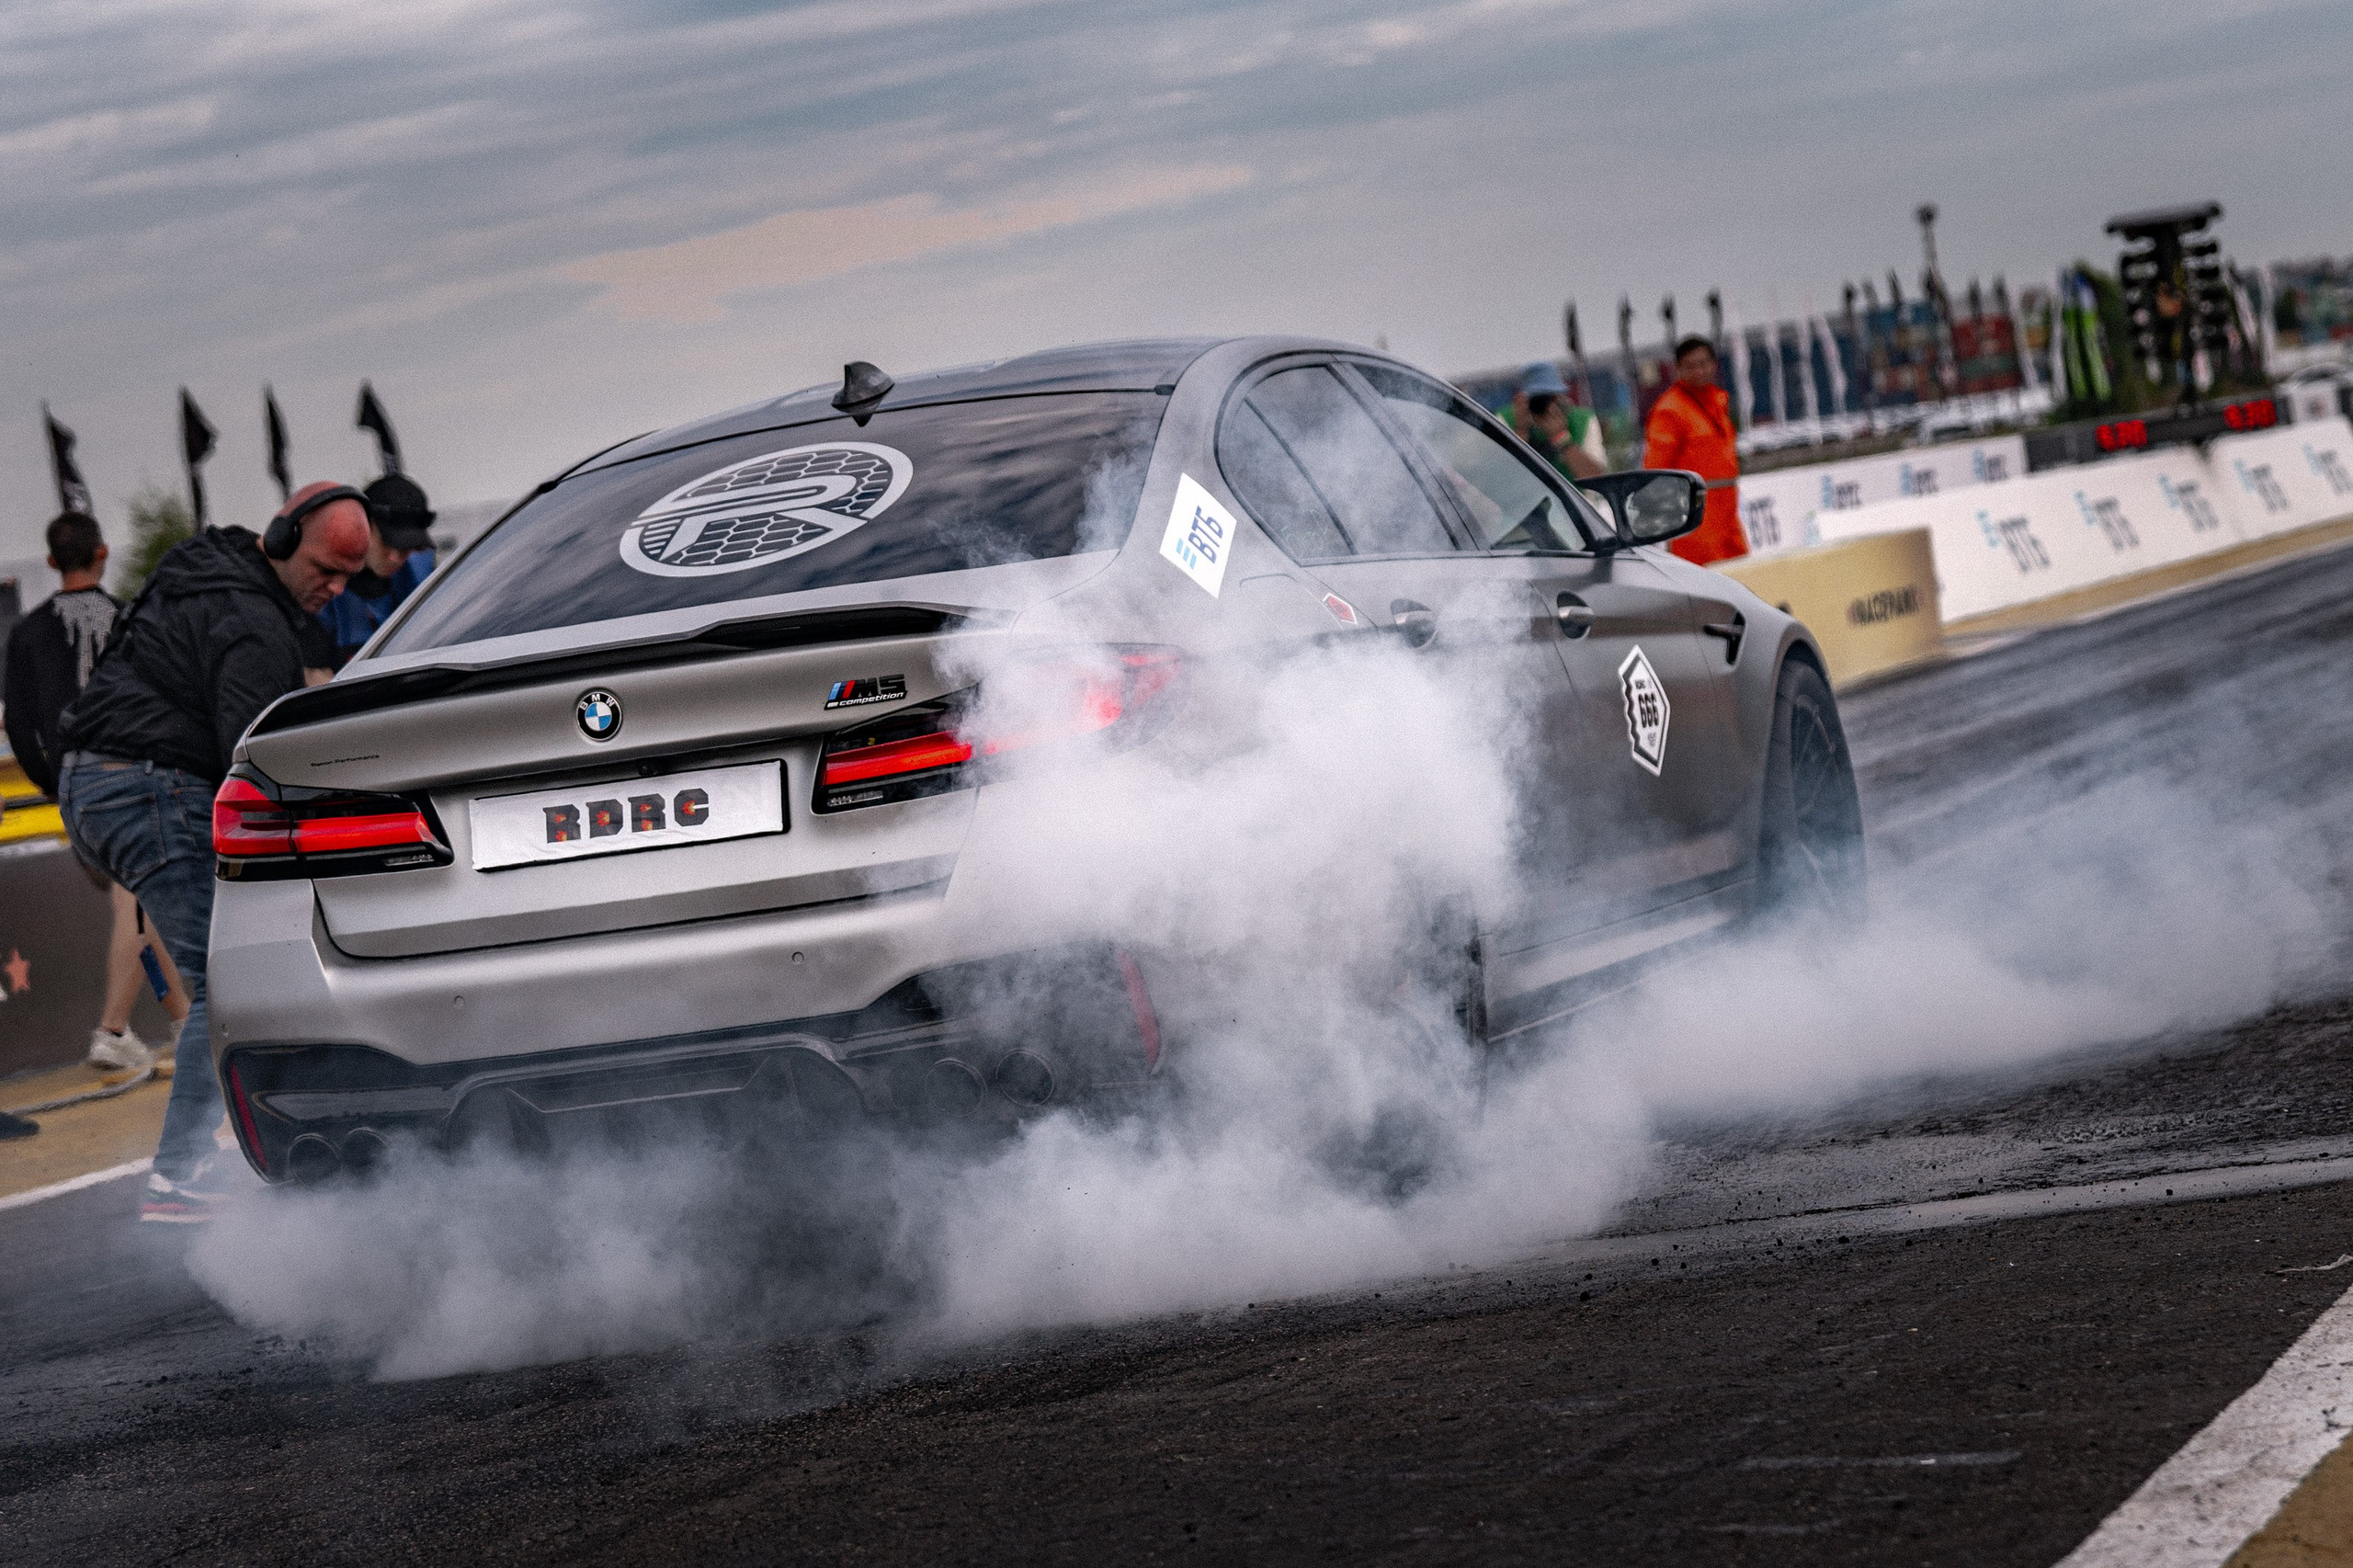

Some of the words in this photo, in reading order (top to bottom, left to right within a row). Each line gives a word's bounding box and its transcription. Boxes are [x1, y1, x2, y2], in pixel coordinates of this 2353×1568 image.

[1188, 505, 1223, 564] ВТБ
[844, 674, 906, 699] M5
[579, 693, 616, 710] BMW
[838, 691, 905, 707] competition
[335, 754, 380, 764] Performance
[542, 787, 710, 845] RDRC
